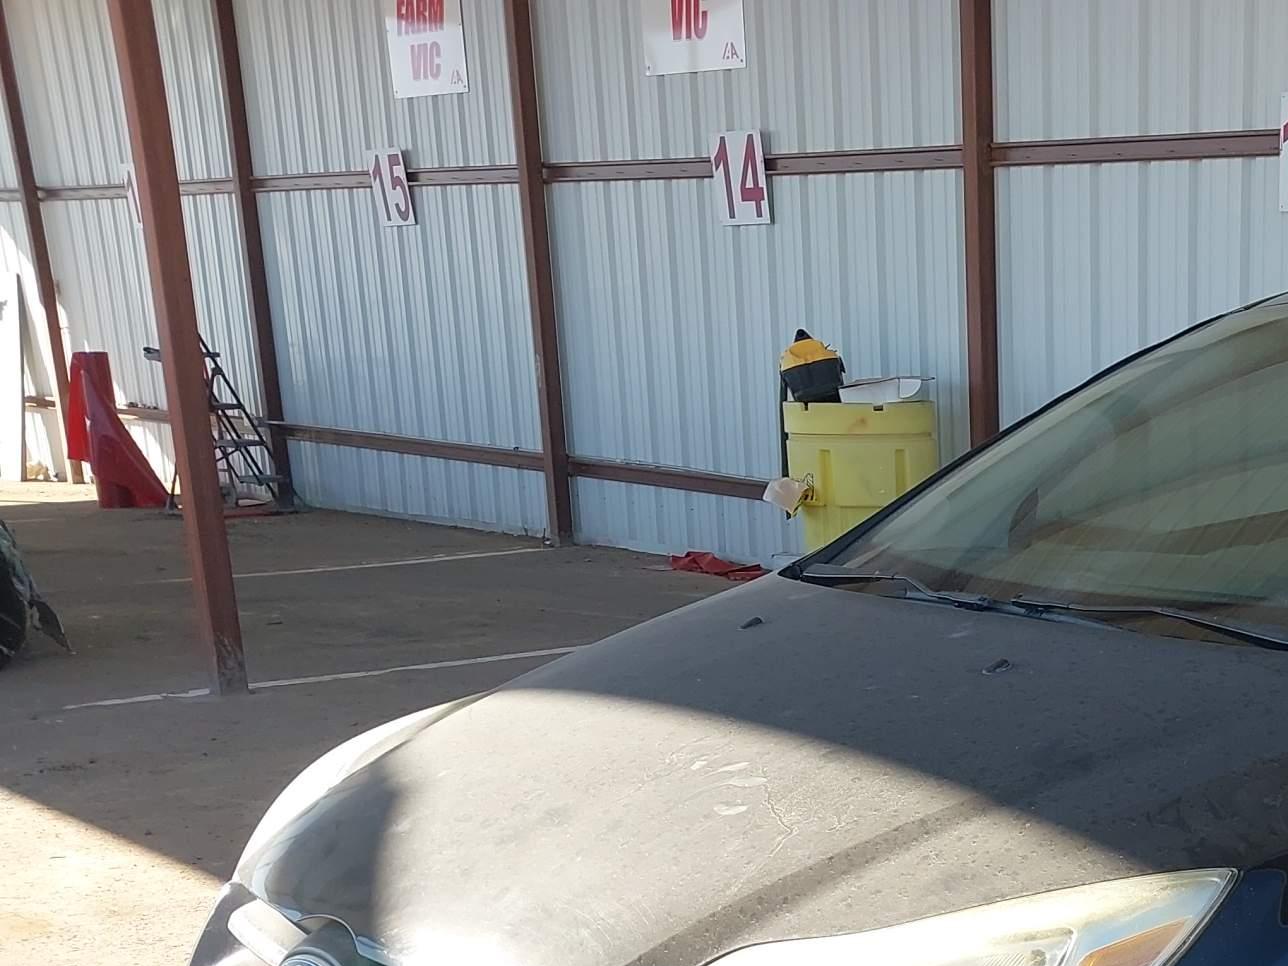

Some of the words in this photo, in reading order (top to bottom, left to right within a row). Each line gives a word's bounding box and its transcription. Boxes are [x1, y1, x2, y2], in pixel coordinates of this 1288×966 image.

[396, 0, 444, 36] FARM
[410, 41, 441, 81] VIC
[372, 153, 410, 222] 15
[713, 133, 765, 219] 14
